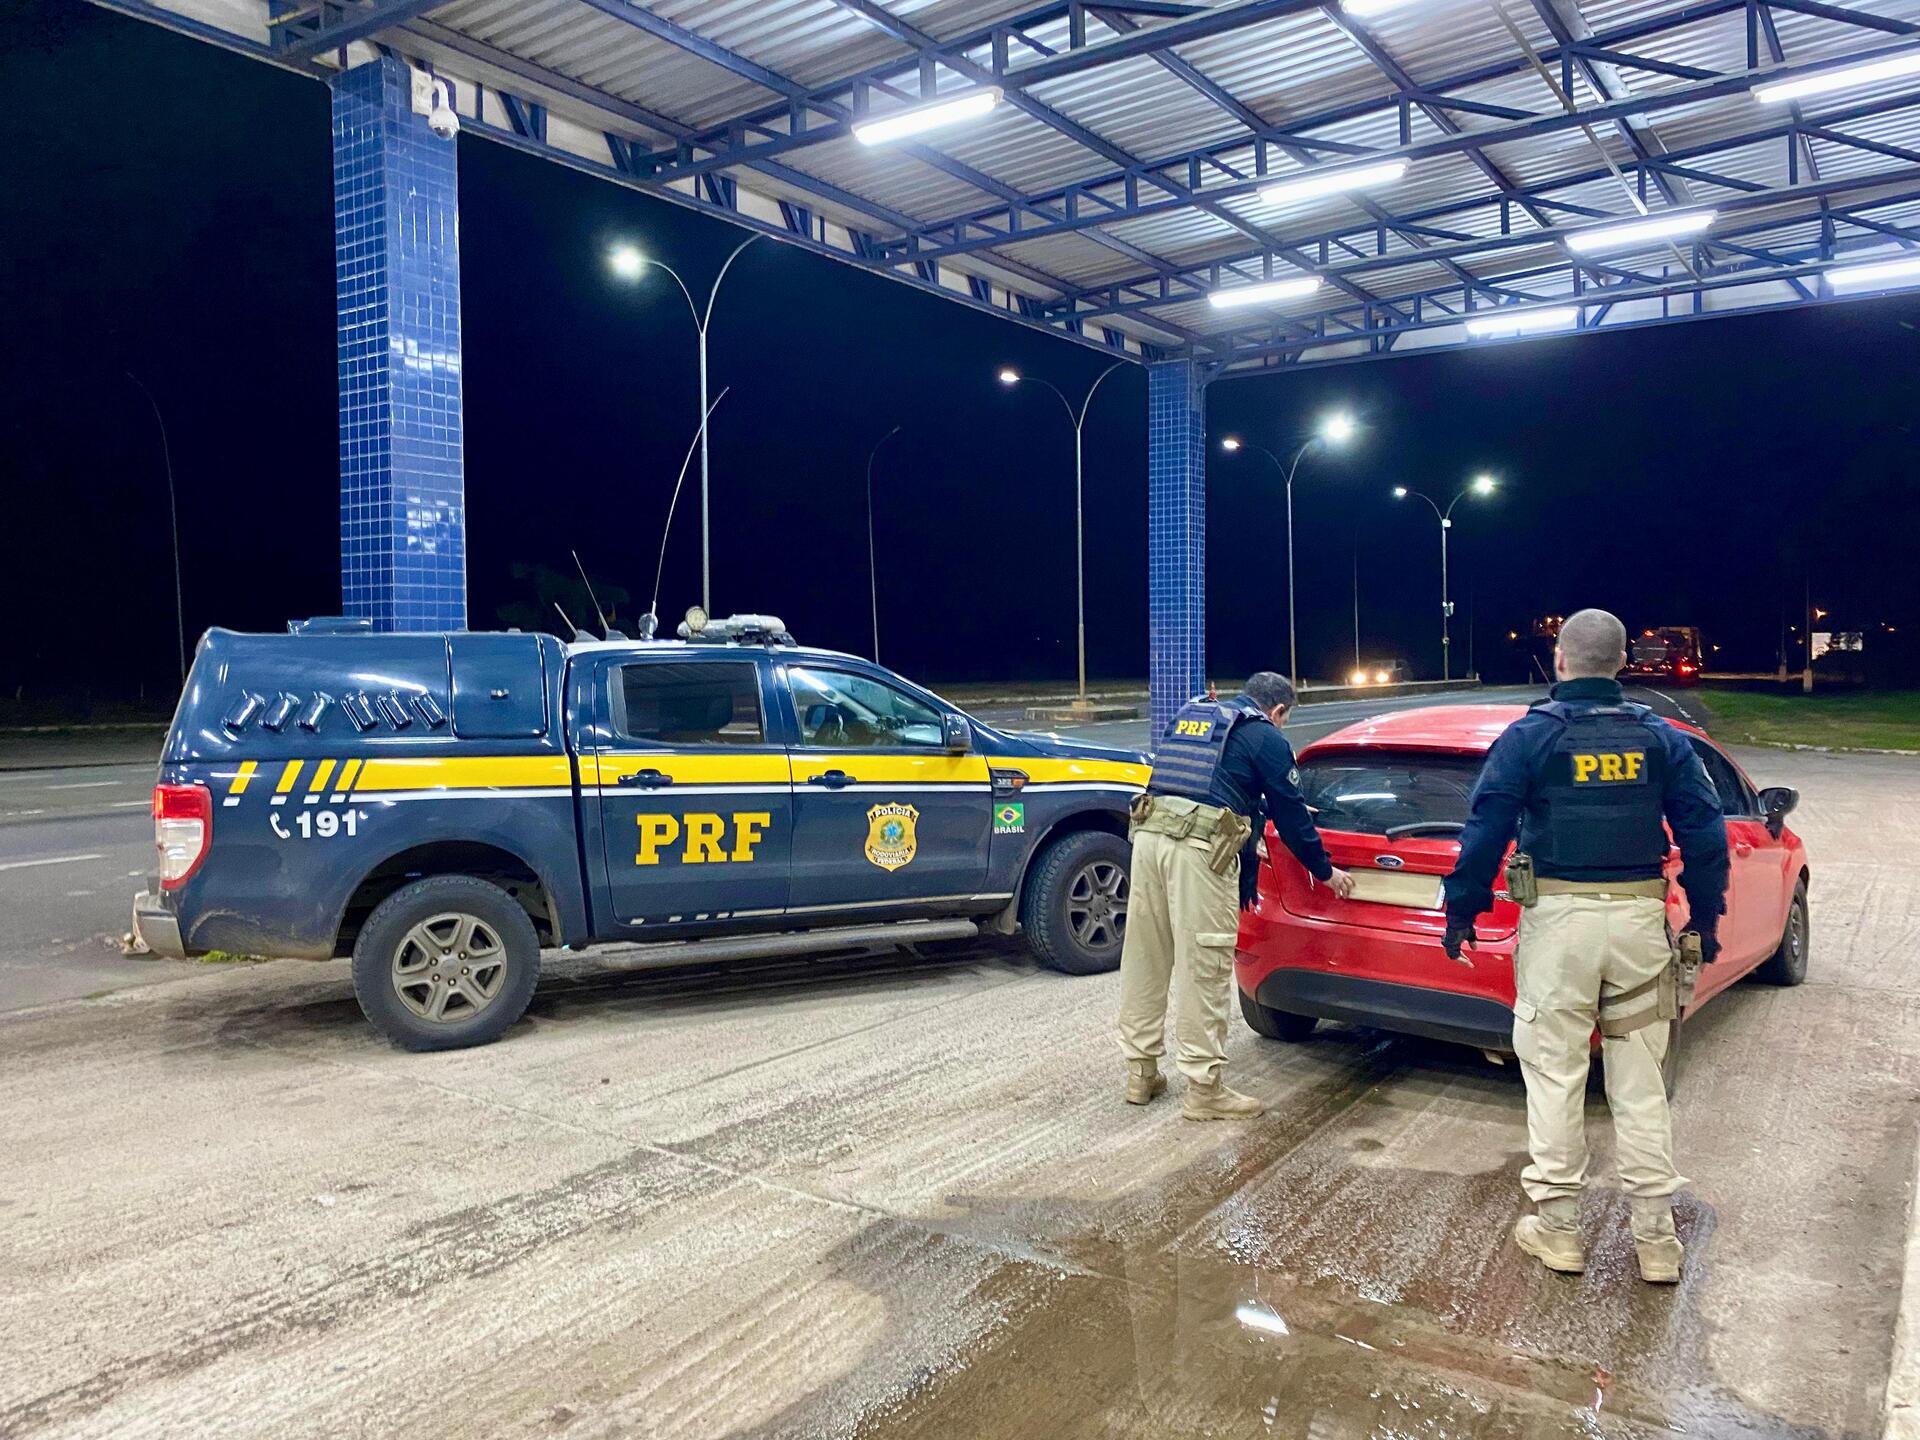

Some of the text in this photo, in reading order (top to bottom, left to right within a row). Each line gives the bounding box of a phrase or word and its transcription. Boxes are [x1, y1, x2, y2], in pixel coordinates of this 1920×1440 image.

[1175, 720, 1212, 736] PRF
[1573, 752, 1645, 782] PRF
[296, 809, 357, 838] 191
[994, 825, 1025, 834] BRASIL
[635, 812, 771, 865] PRF
